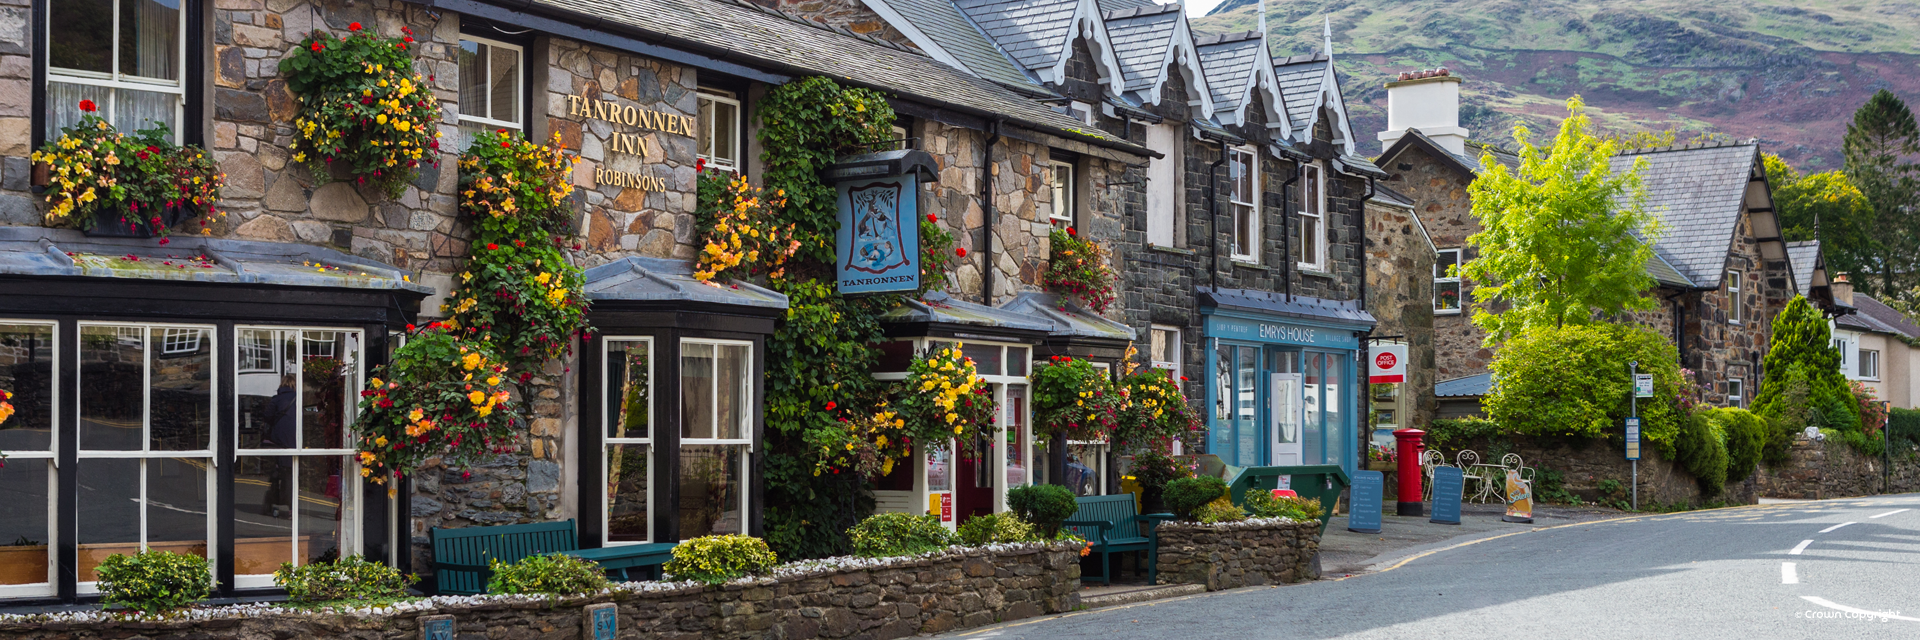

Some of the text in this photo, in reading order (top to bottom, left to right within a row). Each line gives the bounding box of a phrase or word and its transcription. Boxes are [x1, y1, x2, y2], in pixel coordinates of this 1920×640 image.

[568, 94, 693, 137] TANRONNEN
[611, 131, 649, 157] INN
[595, 167, 665, 193] ROBINSONS
[843, 274, 915, 287] TANRONNEN
[1259, 323, 1315, 343] EMRYS HOUSE
[1508, 492, 1530, 504] Solero
